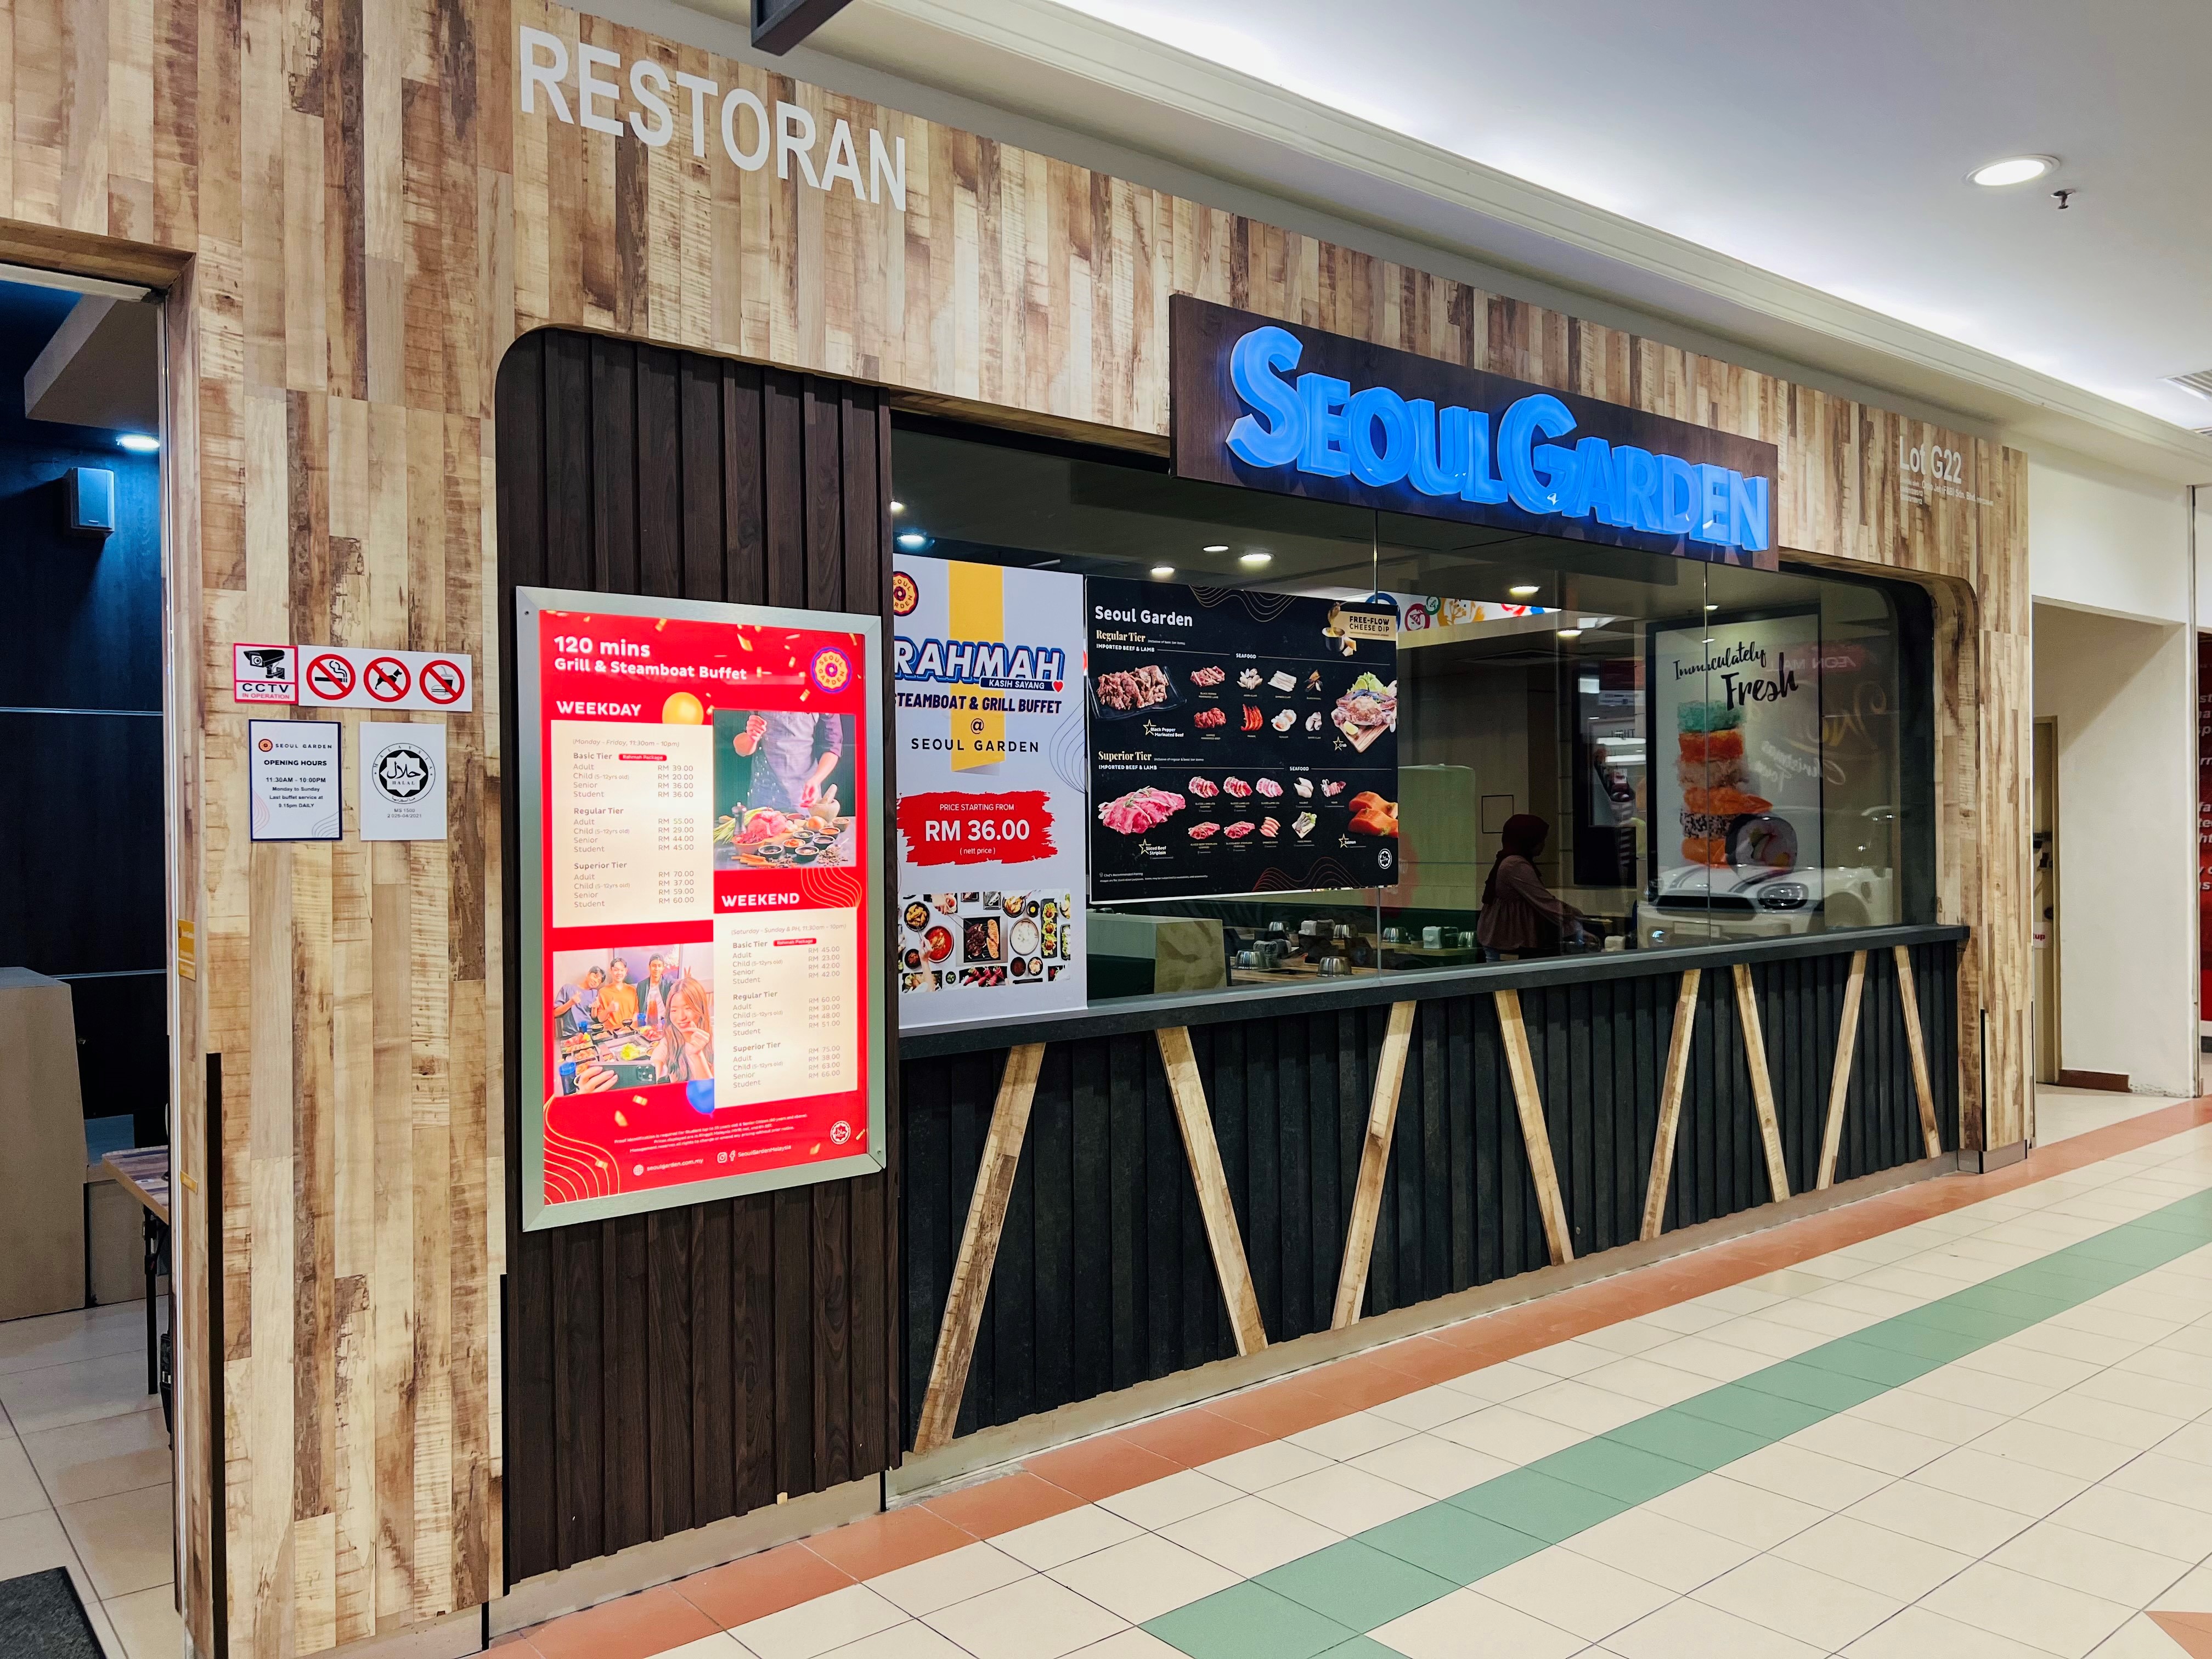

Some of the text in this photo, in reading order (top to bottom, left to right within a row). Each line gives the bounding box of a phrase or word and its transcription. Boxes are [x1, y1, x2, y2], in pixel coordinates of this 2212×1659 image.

[520, 25, 906, 212] RESTORAN
[1900, 435, 1962, 484] Lot G22
[893, 579, 911, 591] EOUL
[1095, 605, 1193, 627] Seoul Garden
[1349, 616, 1390, 625] FREE-FLOW
[1349, 623, 1376, 631] CHEESE
[1096, 630, 1128, 642] Regular
[1128, 632, 1146, 642] Tier
[554, 636, 651, 657] 120 mins
[819, 655, 843, 668] SEOUL
[894, 637, 1063, 682] RAHMAH
[554, 658, 747, 680] Grill & Steamboat Buffet
[818, 668, 845, 685] GARDEN
[242, 682, 289, 693] CCTV
[989, 679, 1045, 690] KASIH SAYANG
[1722, 652, 1799, 711] Fresh
[556, 700, 641, 716] WEEKDAY
[895, 692, 1062, 714] TEAMBOAT & GRILL BUFFET
[970, 718, 984, 735] @
[911, 738, 1039, 753] SEOUL GARDEN
[373, 745, 433, 770] MALAYSIA
[1098, 751, 1134, 762] Superior
[1135, 751, 1152, 761] Tier
[387, 761, 421, 779] حلال
[574, 807, 606, 815] Regular
[961, 803, 994, 811] STARTING
[924, 819, 1030, 842] RM 36.00
[977, 847, 992, 855] price
[721, 893, 800, 907] WEEKEND
